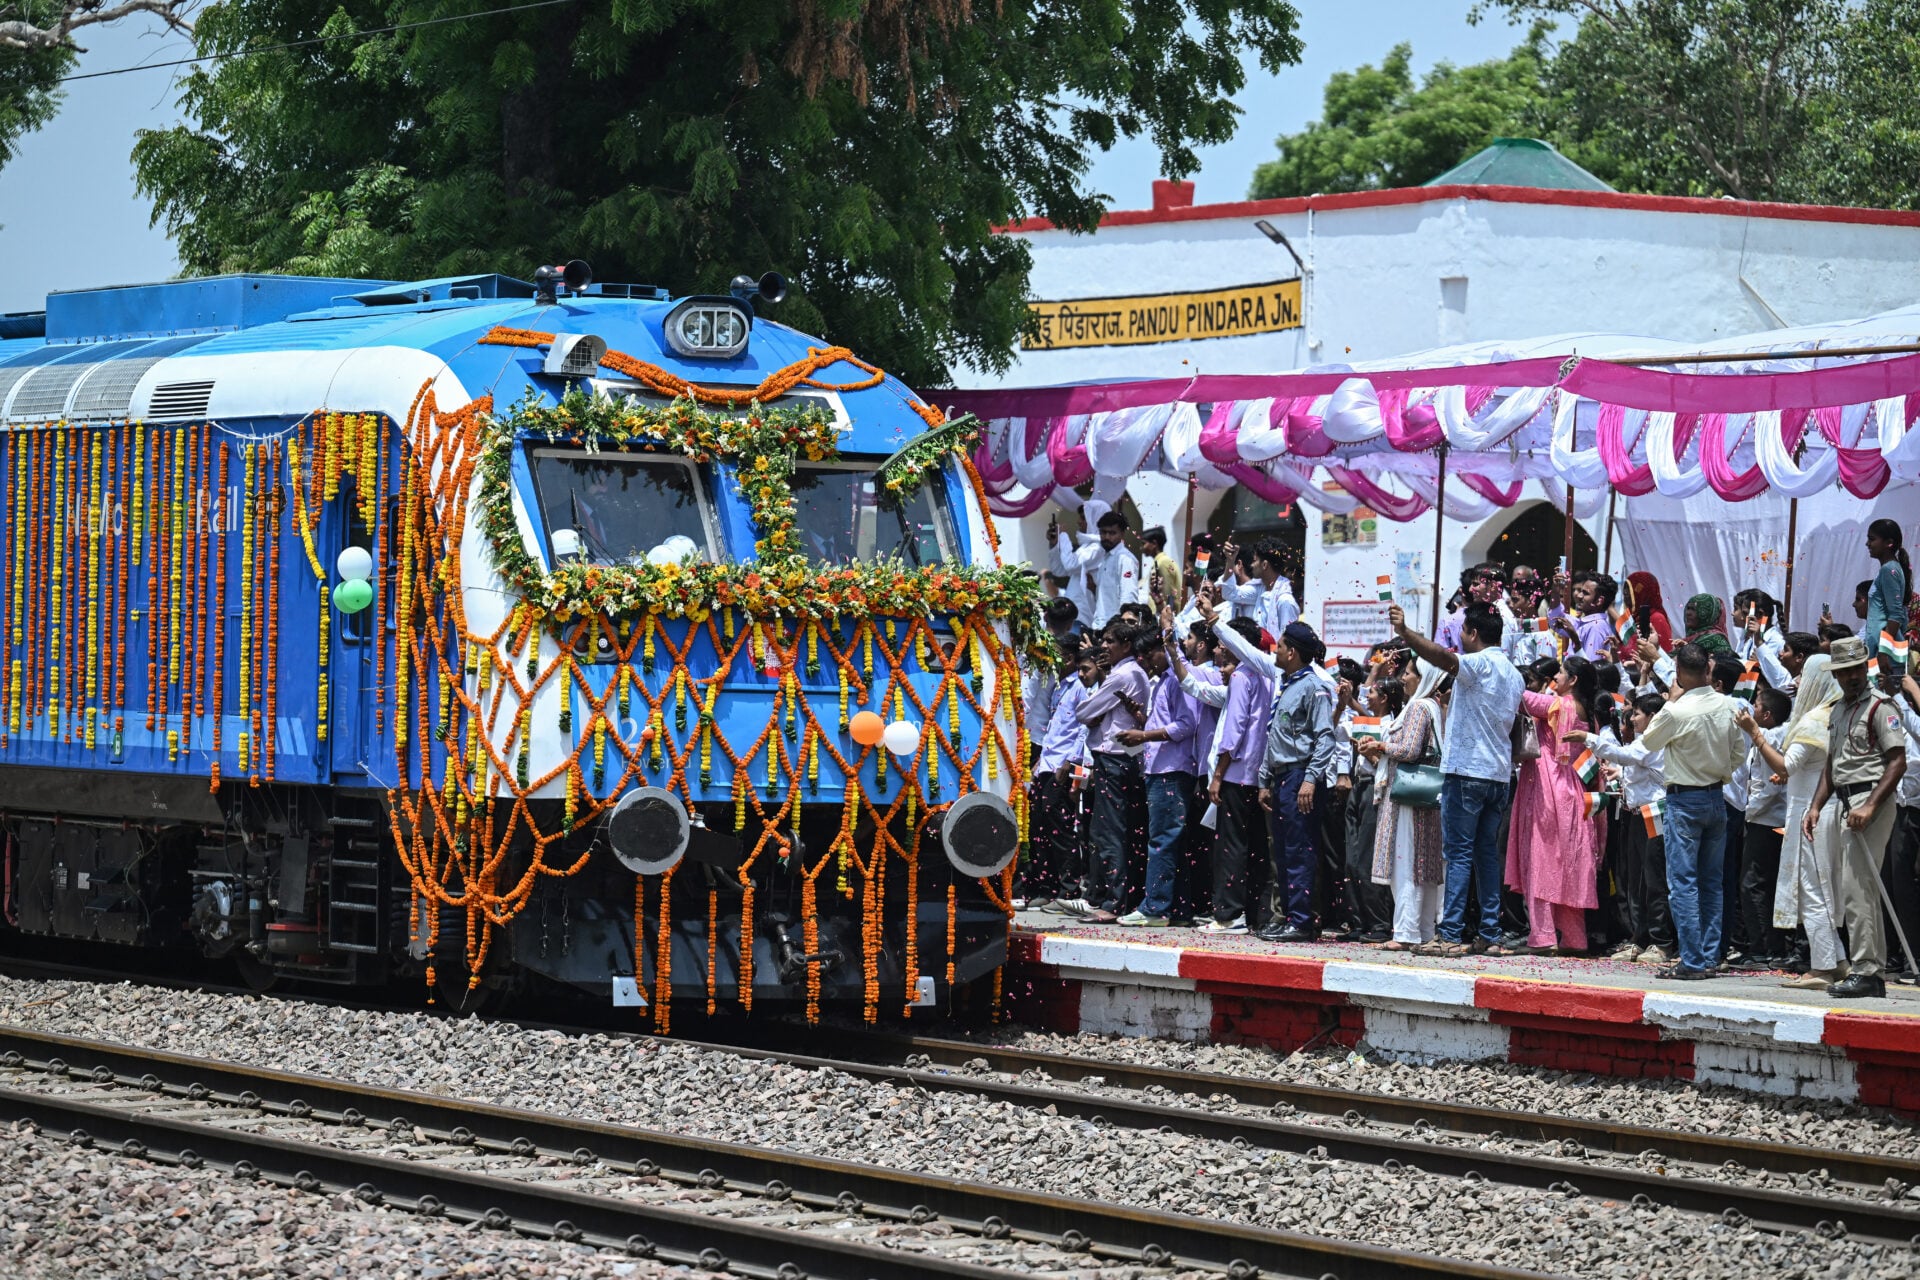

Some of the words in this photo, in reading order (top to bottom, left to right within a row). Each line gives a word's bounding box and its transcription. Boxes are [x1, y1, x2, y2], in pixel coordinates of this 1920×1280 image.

[1129, 305, 1179, 337] PANDU
[1186, 296, 1267, 333] PINDARA
[196, 485, 238, 534] Rail
